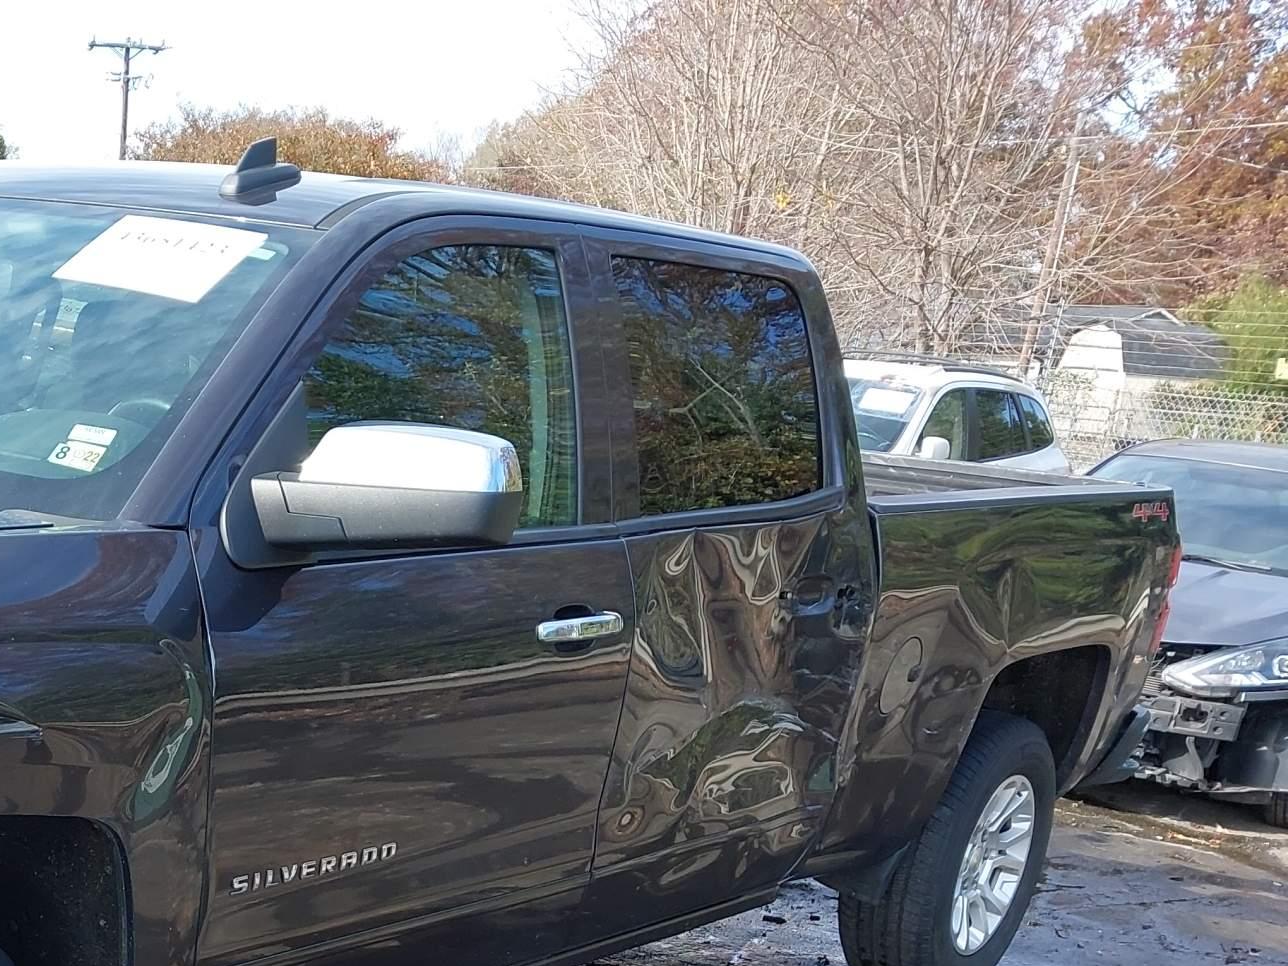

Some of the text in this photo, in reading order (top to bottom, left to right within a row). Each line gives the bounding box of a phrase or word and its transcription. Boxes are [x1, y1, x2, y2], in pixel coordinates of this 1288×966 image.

[55, 446, 101, 464] 8 22
[230, 842, 398, 895] SILVERADO
